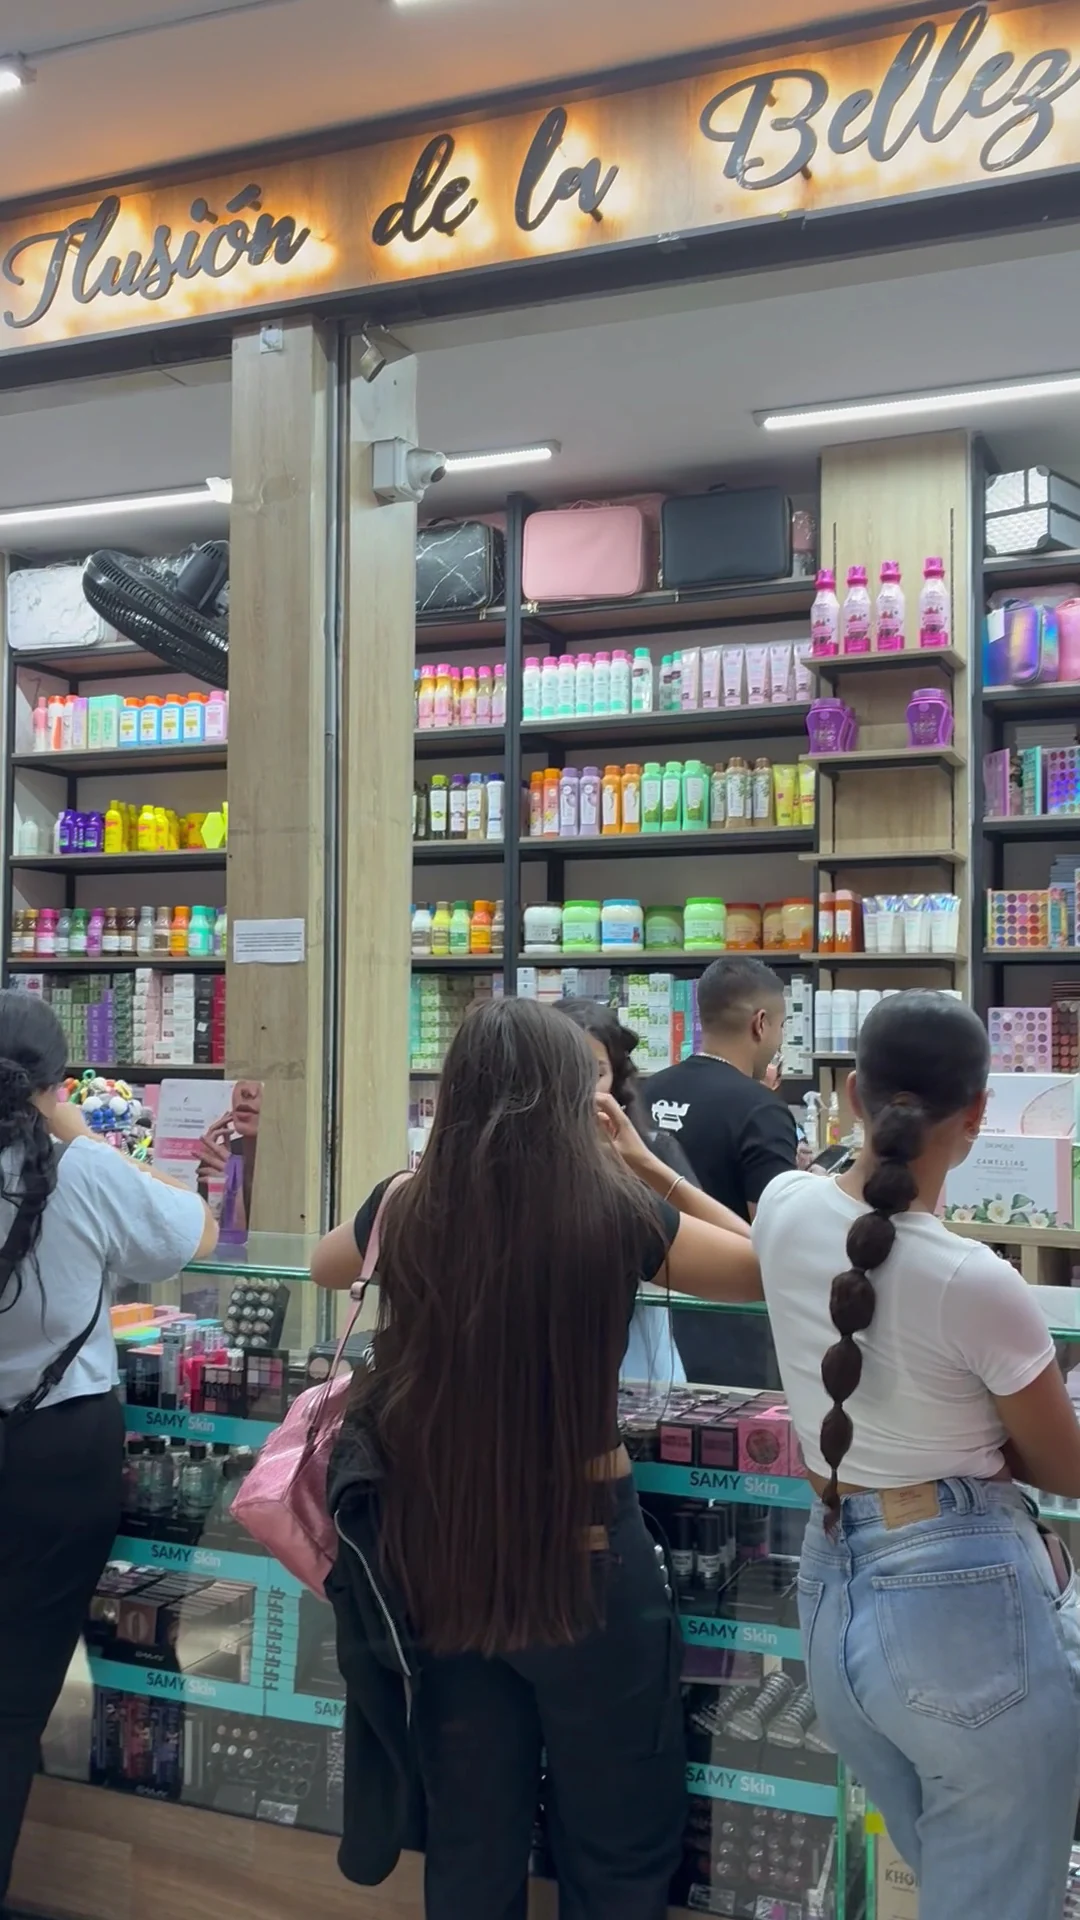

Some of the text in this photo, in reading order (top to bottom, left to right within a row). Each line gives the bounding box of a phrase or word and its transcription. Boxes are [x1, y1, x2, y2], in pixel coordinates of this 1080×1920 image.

[2, 183, 311, 328] Ilusión
[372, 133, 479, 246] de
[515, 107, 620, 231] la
[146, 1411, 215, 1432] SAMY Skin
[690, 1471, 779, 1495] SAMY Skin
[151, 1544, 221, 1567] SAMY Skin
[688, 1620, 777, 1645] SAMY Skin
[146, 1672, 217, 1696] SAMY Skin
[686, 1767, 776, 1797] SAMY Skin
